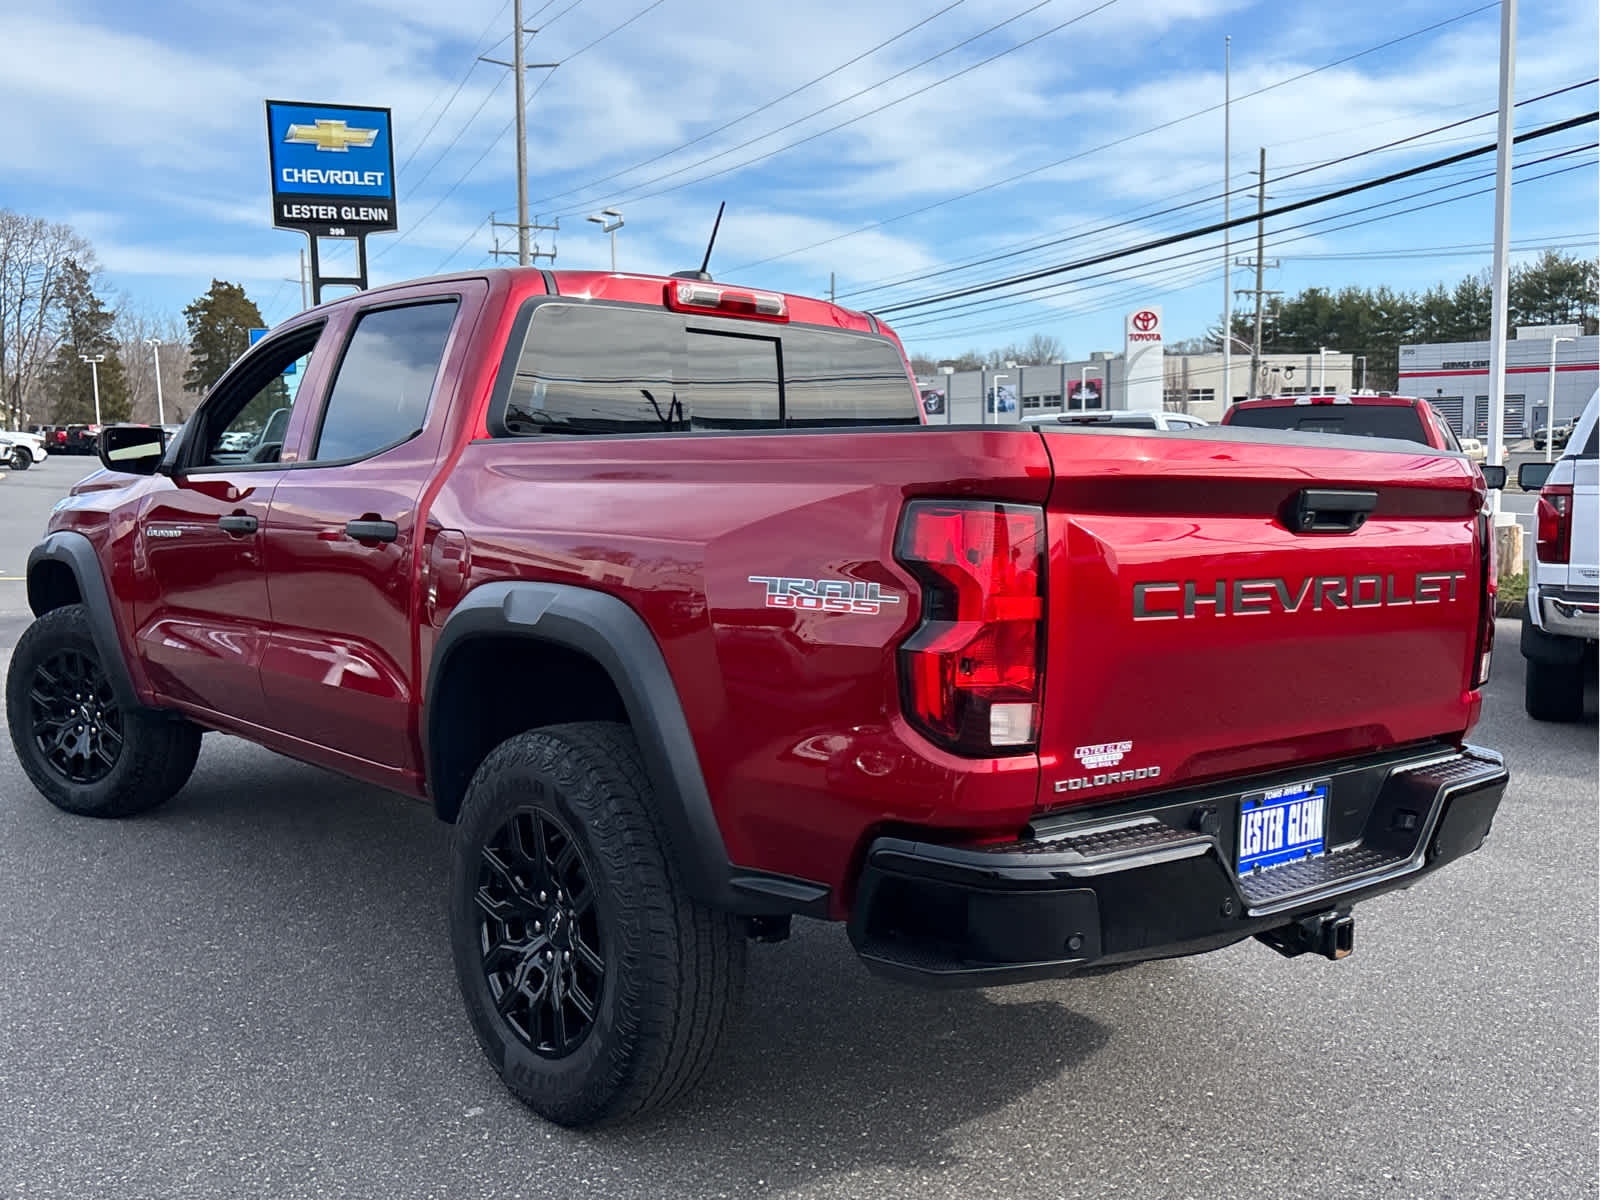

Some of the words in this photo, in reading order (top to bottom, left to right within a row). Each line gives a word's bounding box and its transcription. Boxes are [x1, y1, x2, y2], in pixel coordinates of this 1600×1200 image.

[282, 168, 385, 186] CHEVROLET
[283, 204, 338, 219] LESTER
[341, 207, 389, 221] GLENN
[1128, 333, 1162, 342] TOYOTA
[1442, 361, 1470, 370] SERVICE
[1471, 359, 1490, 368] CENT
[748, 576, 900, 603] TRAIL
[1133, 571, 1467, 622] CHEVROLET
[766, 593, 880, 615] BOSS
[1054, 766, 1161, 793] COLORADO
[1239, 806, 1285, 858] LESTER
[1287, 798, 1325, 846] GLENN
